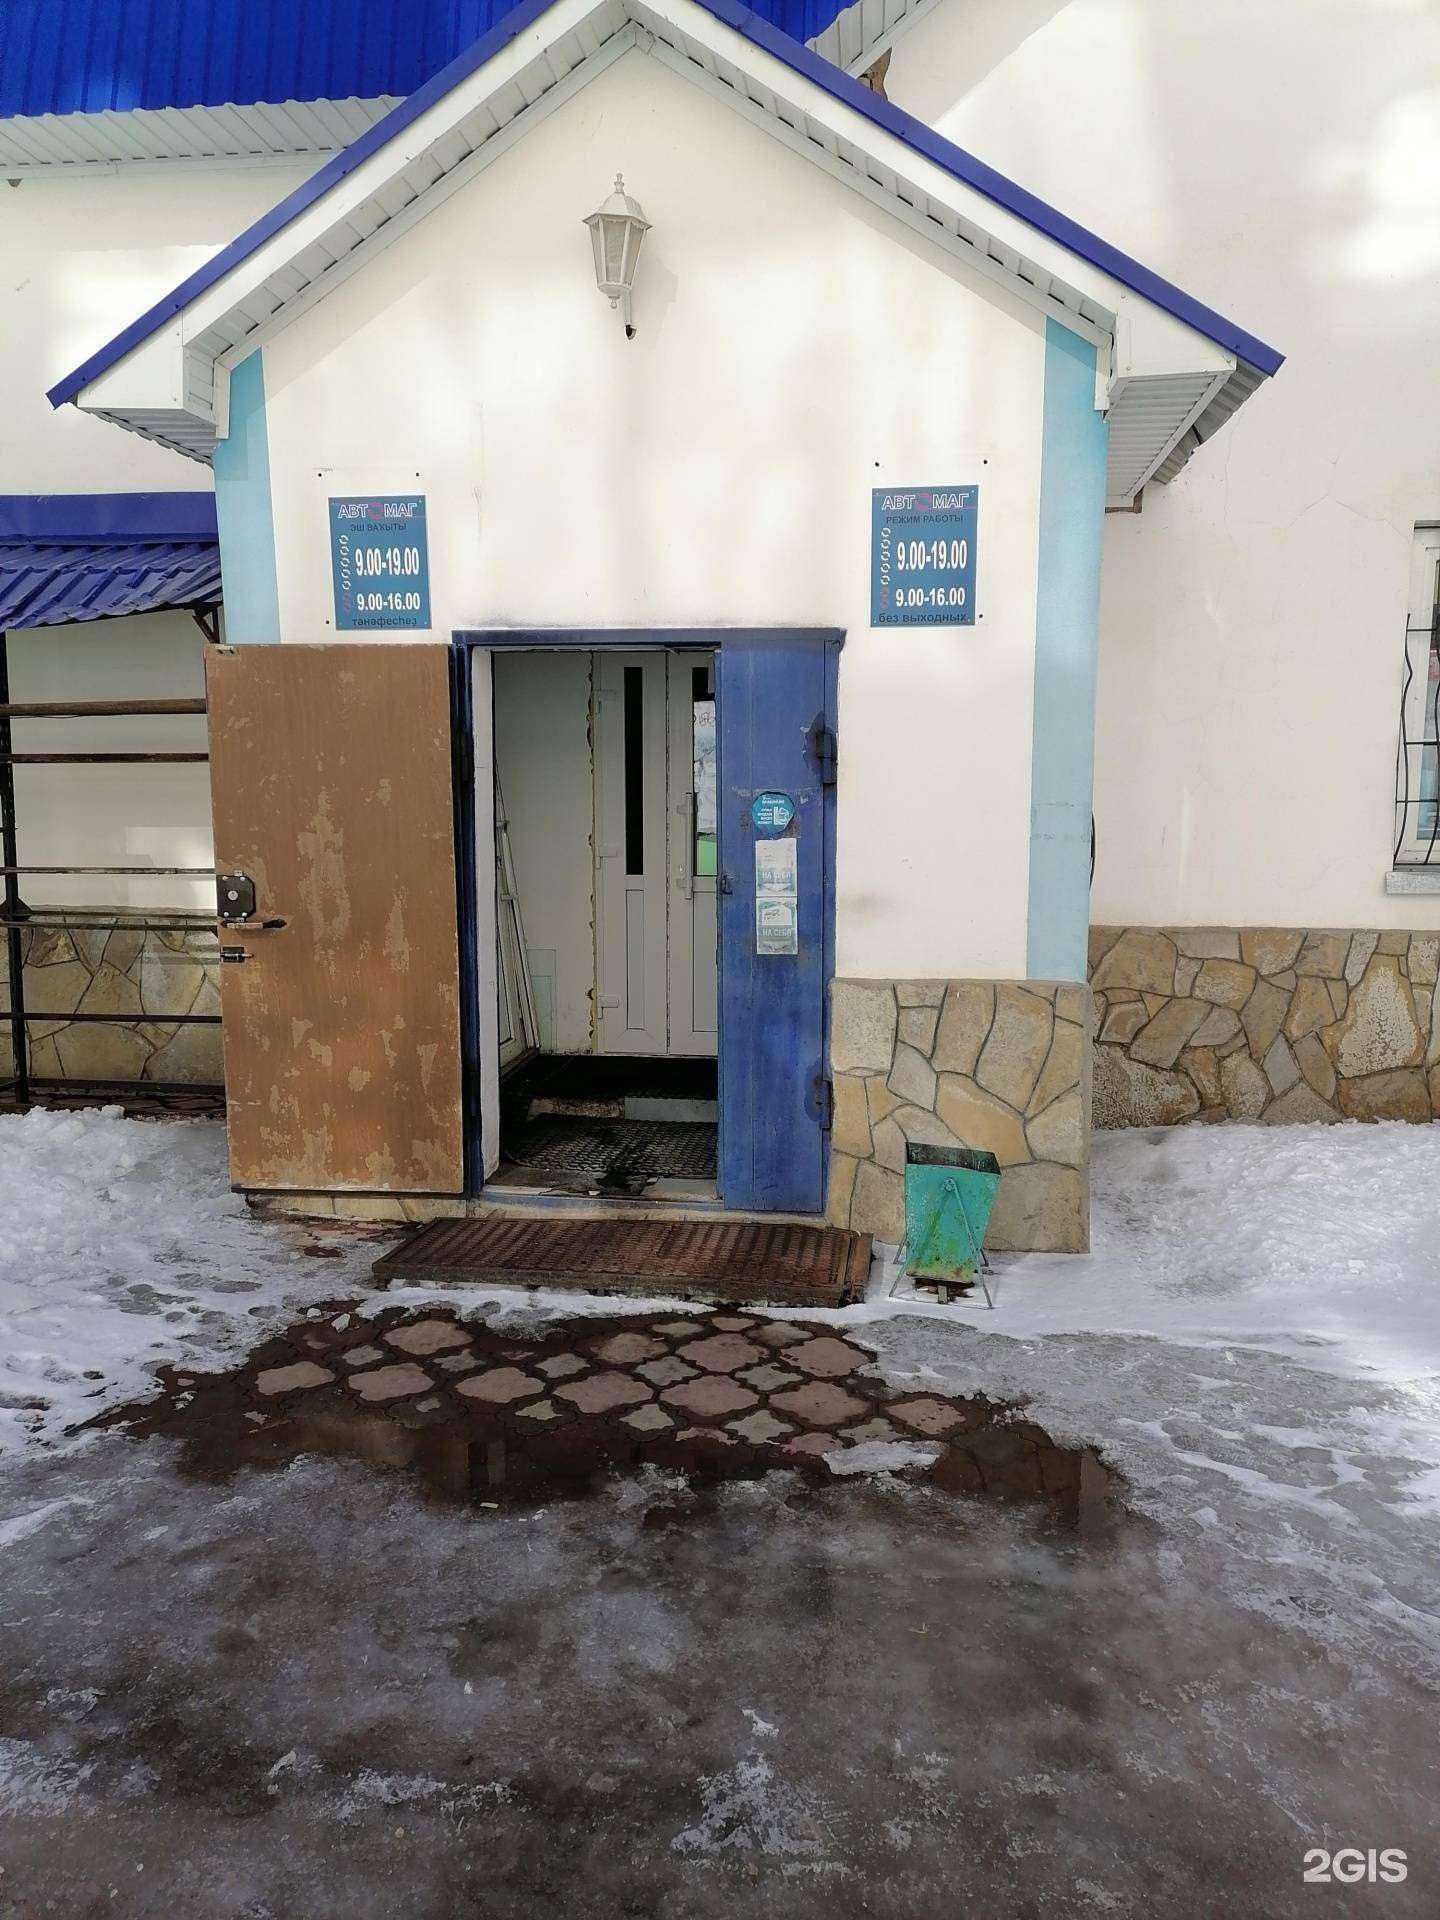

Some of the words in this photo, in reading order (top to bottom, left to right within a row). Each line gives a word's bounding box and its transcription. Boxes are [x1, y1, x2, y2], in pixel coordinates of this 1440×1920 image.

[886, 515, 920, 524] РЕЖИМ
[923, 514, 963, 523] РАБОТЫ
[355, 547, 419, 576] 9.00-19.00
[897, 540, 967, 570] 9.00-19.00
[357, 592, 420, 611] 9.00-16.00
[896, 587, 965, 607] 9.00-16.00
[879, 613, 899, 623] без
[902, 613, 968, 624] выходных
